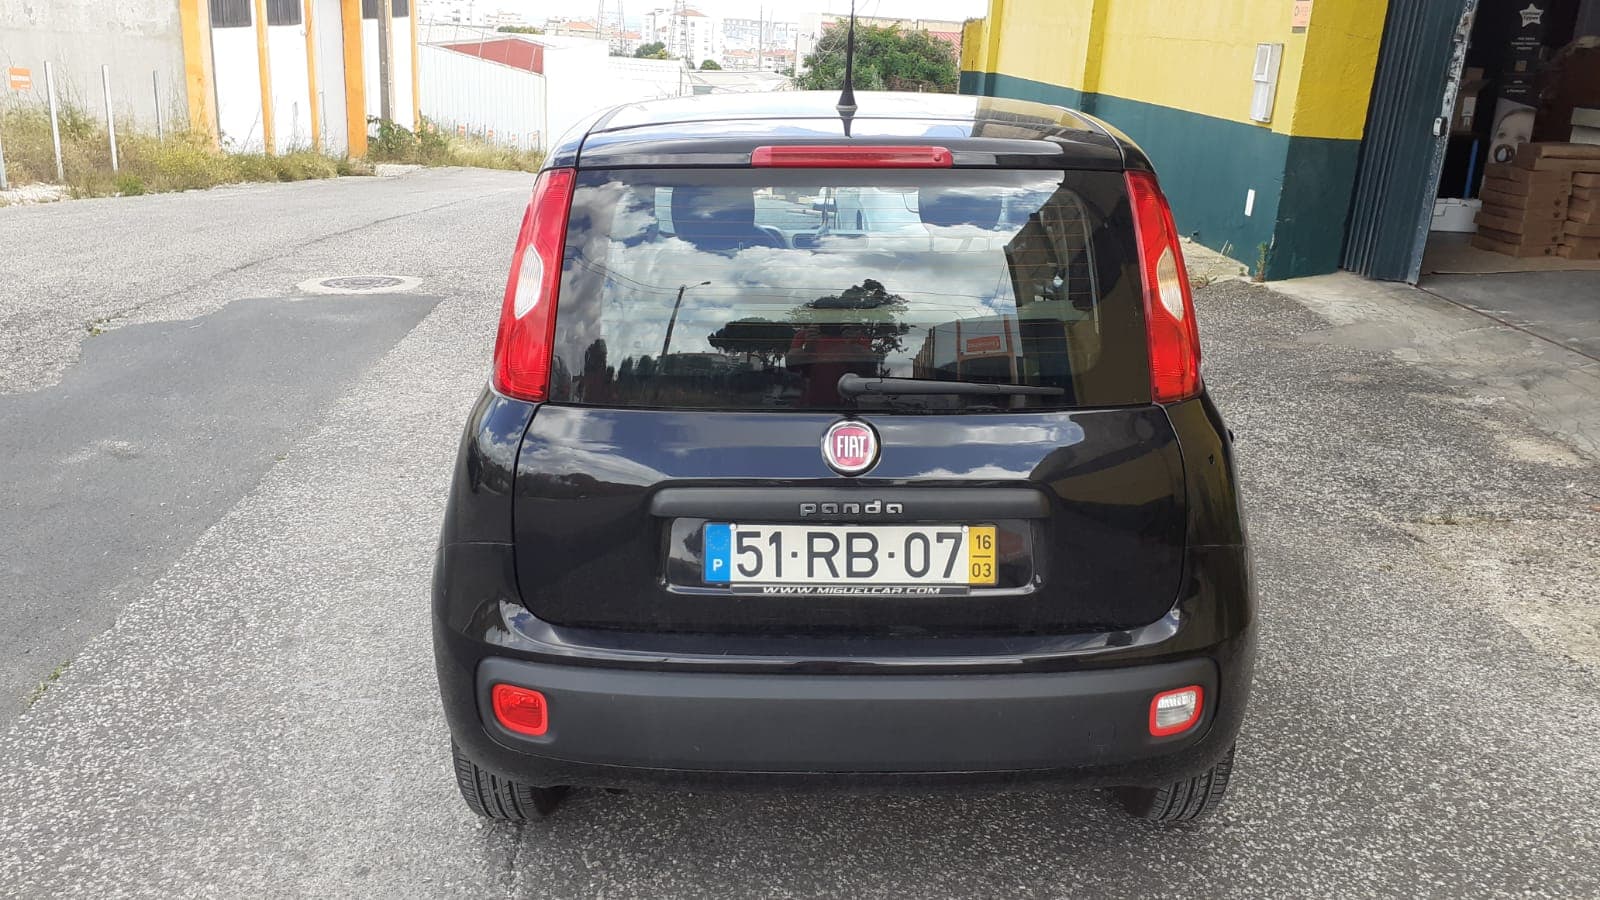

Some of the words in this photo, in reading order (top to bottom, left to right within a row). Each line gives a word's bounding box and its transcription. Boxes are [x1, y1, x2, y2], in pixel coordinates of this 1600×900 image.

[837, 435, 867, 458] FIAT
[799, 500, 903, 517] panda
[975, 535, 991, 550] 16
[712, 558, 723, 571] P
[972, 562, 992, 578] 03
[762, 586, 941, 595] WWW.MIGUELCAR.COM
